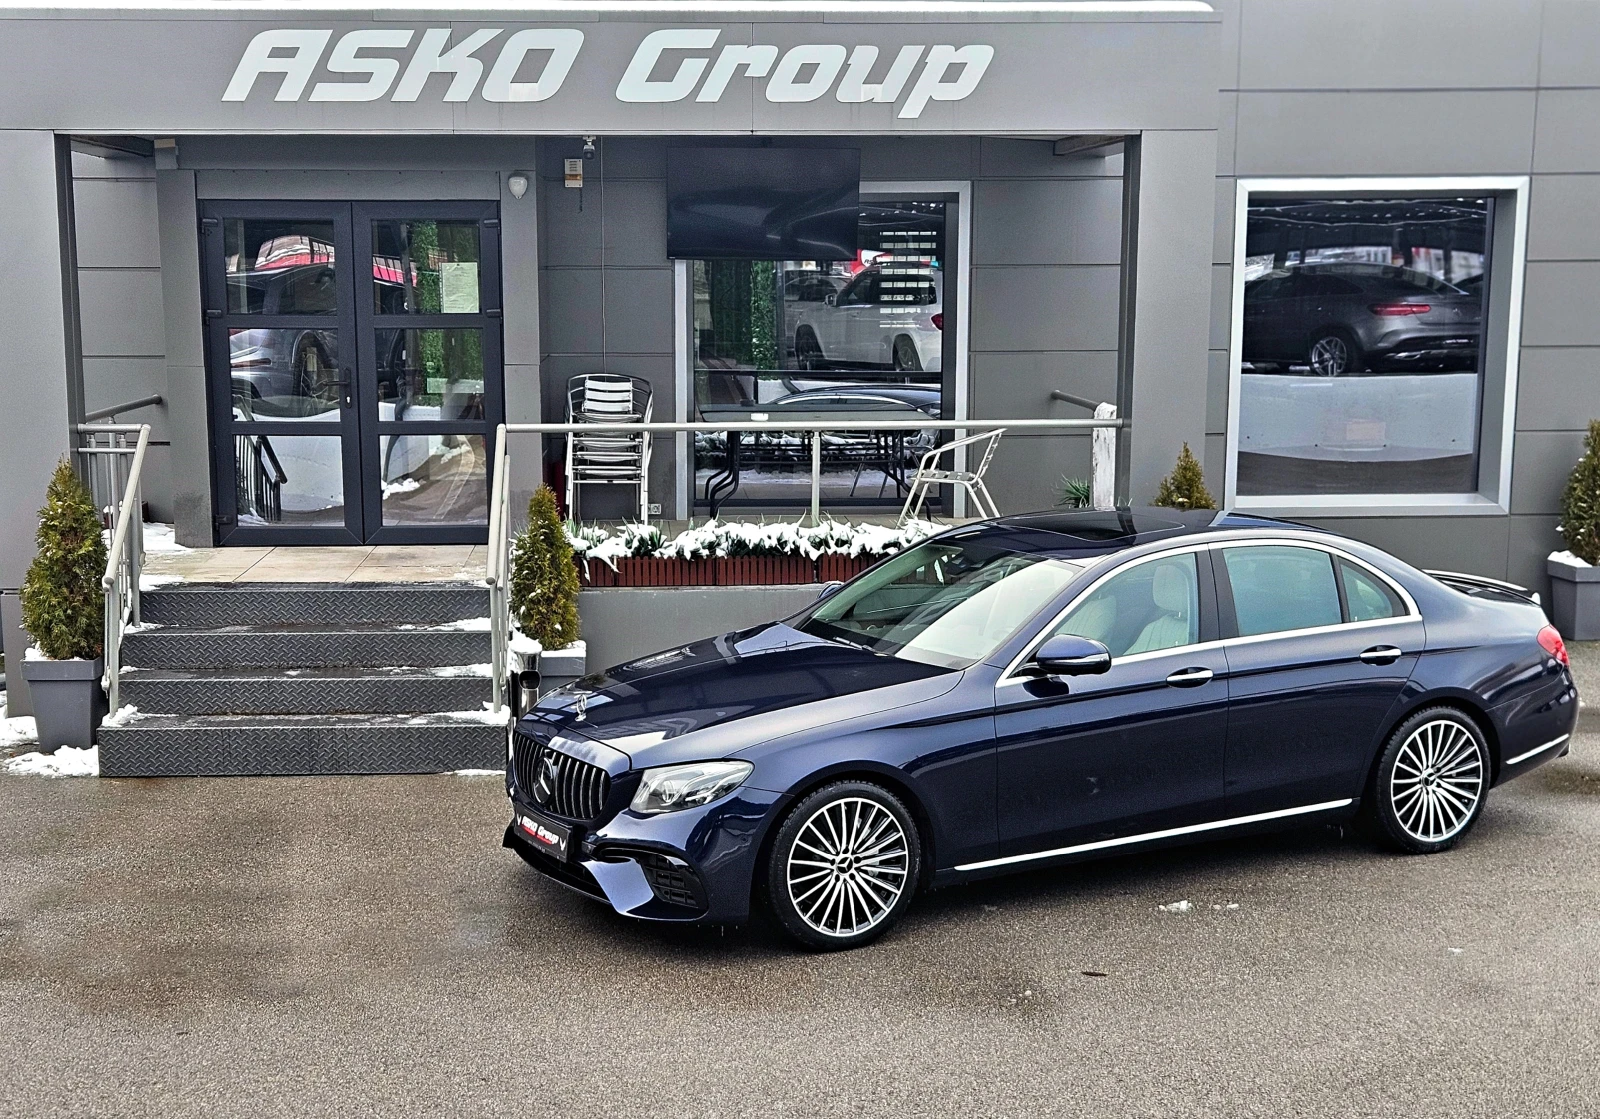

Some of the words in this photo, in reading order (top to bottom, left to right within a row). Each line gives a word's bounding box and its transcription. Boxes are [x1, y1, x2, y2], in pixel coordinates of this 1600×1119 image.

[221, 28, 585, 103] ASKO
[615, 28, 995, 119] Group
[537, 825, 560, 845] Group
